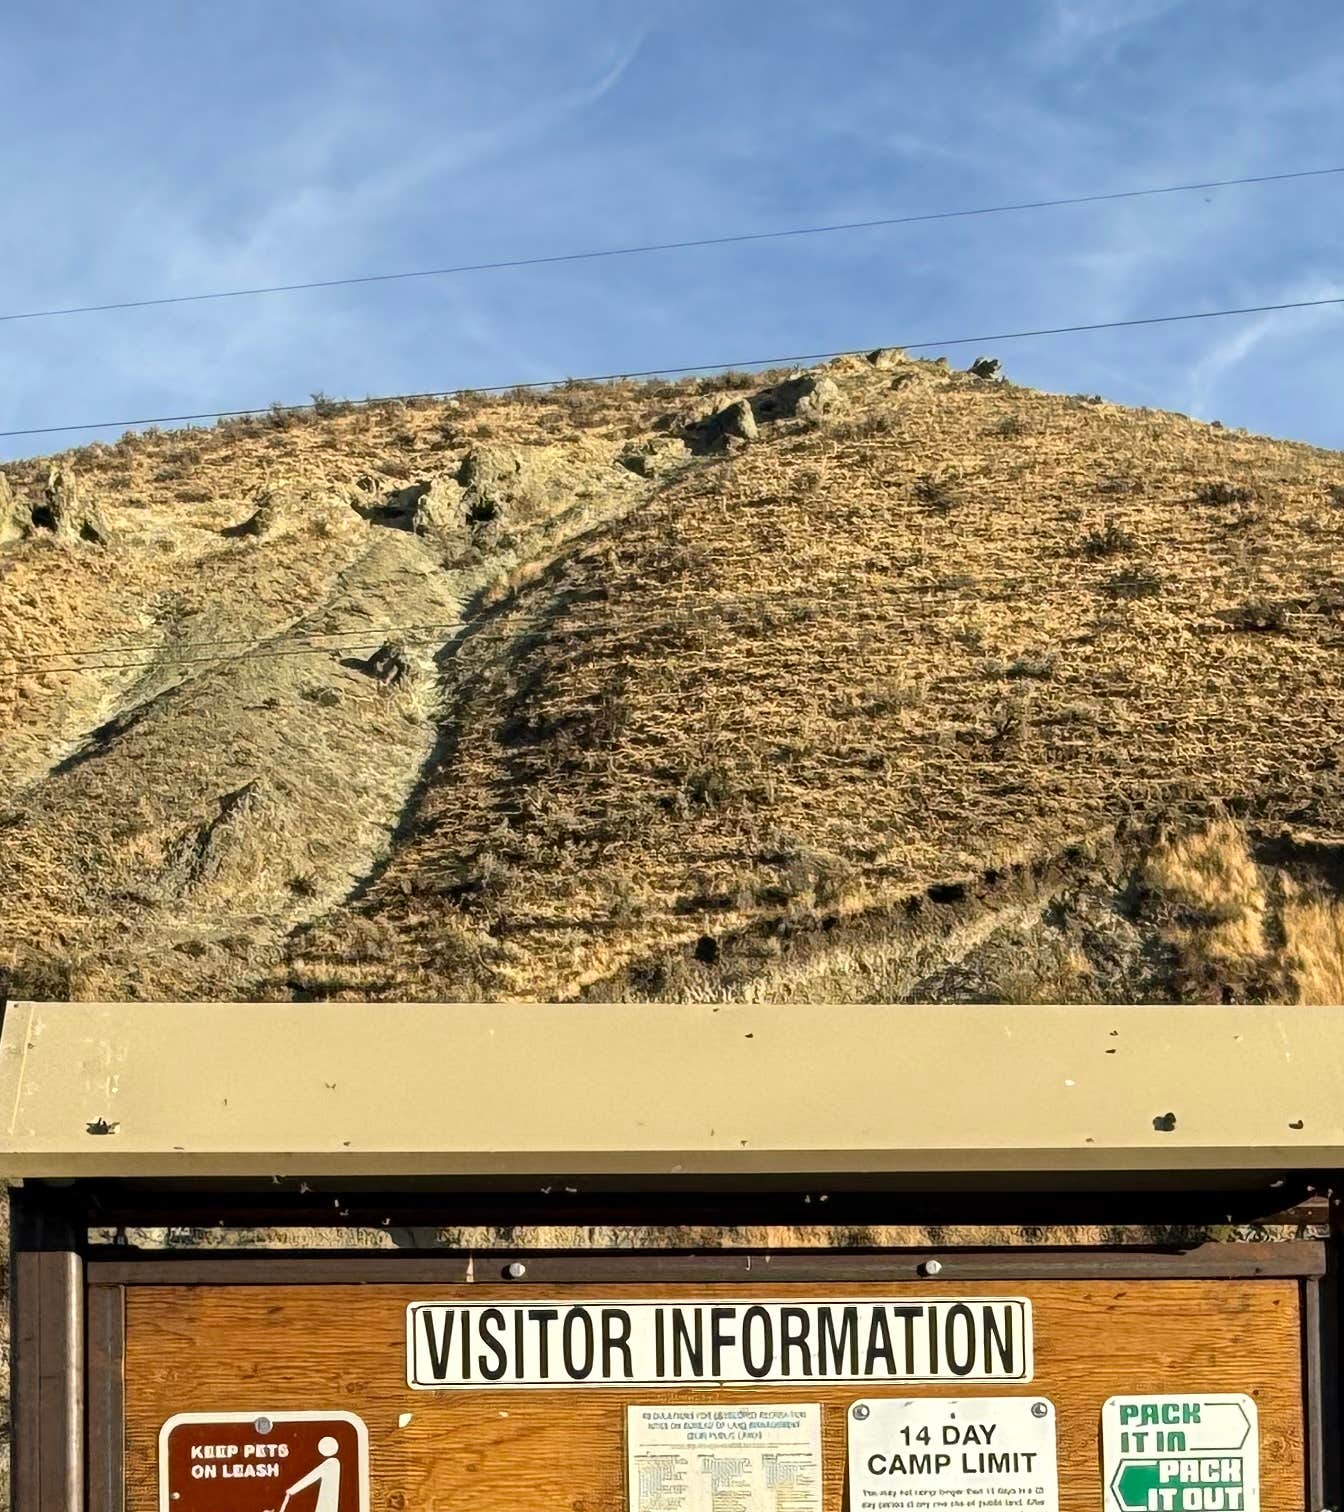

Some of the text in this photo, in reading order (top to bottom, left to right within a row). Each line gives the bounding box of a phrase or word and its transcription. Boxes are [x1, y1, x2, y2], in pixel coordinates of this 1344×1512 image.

[422, 1303, 1014, 1380] VISITOR INFORMATION
[1120, 1403, 1201, 1425] PACK
[900, 1424, 997, 1446] 14 DAY
[1121, 1431, 1186, 1452] IT IN
[191, 1444, 289, 1459] KEEP PETS
[191, 1463, 279, 1479] ON LEASH
[868, 1452, 1037, 1475] CAMP LIMIT
[1159, 1459, 1242, 1483] PACK
[1148, 1487, 1243, 1511] IT OUT
